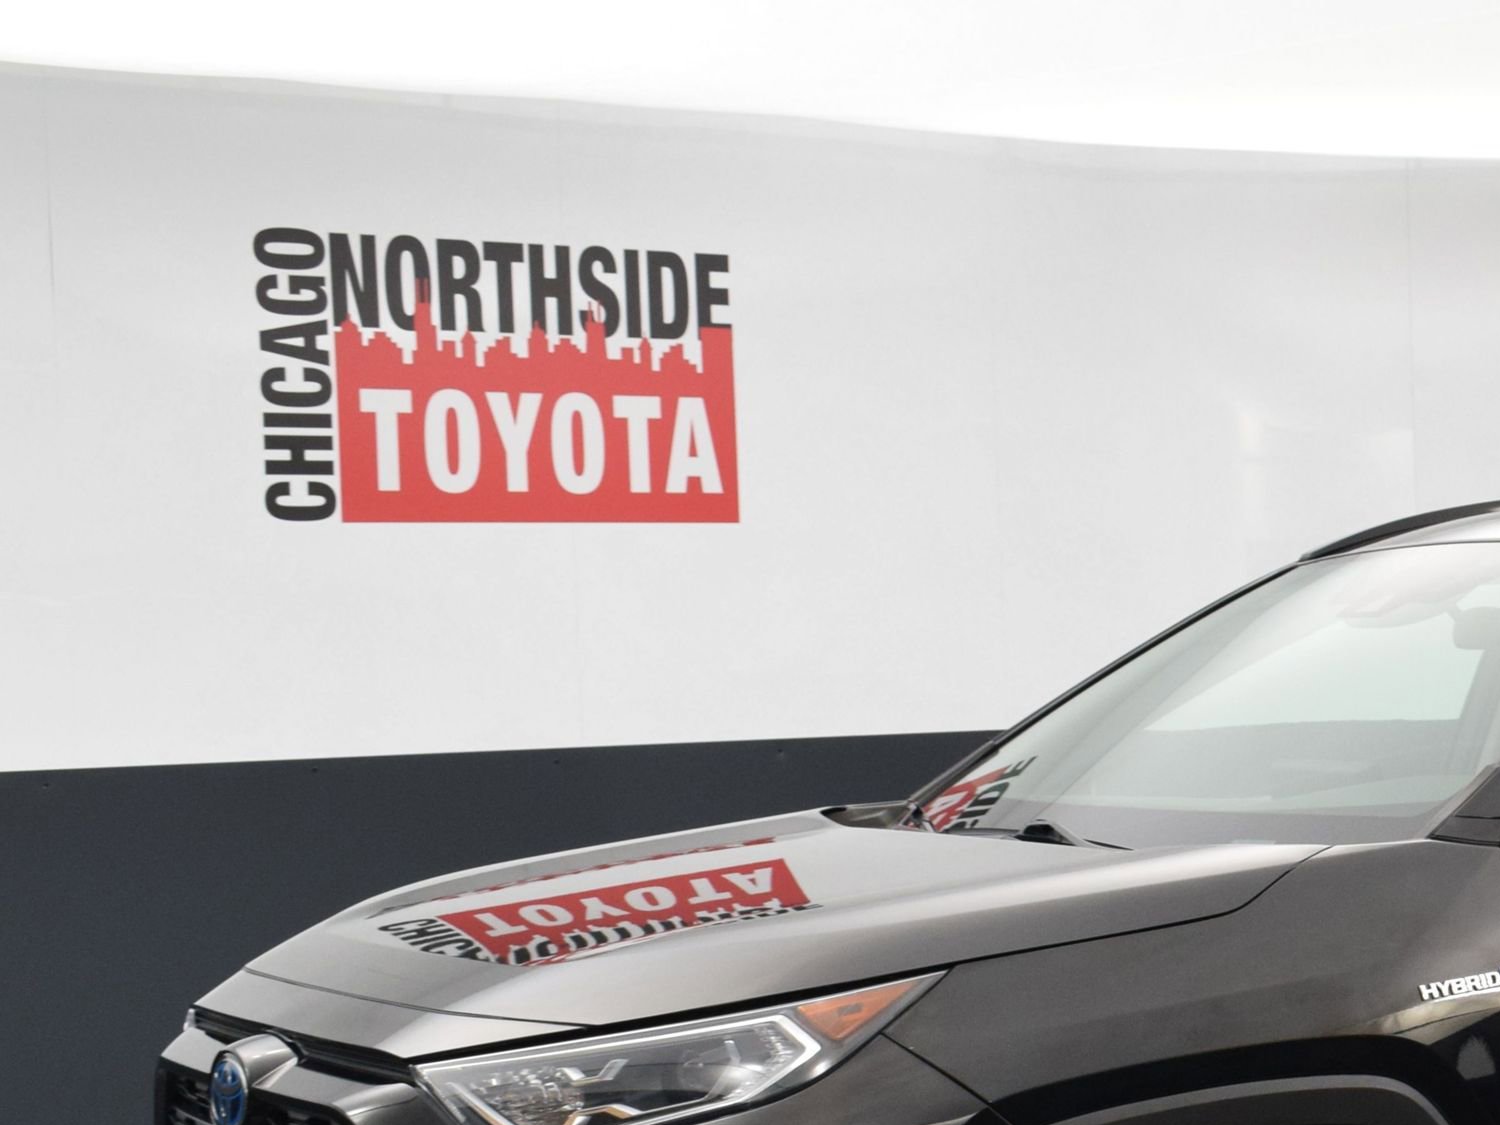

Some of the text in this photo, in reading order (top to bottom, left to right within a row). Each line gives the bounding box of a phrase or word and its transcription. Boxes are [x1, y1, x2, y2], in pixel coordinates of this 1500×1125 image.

[328, 232, 733, 340] NORTHSIDE
[253, 227, 336, 522] CHICAGO
[359, 388, 724, 494] TOYOTA
